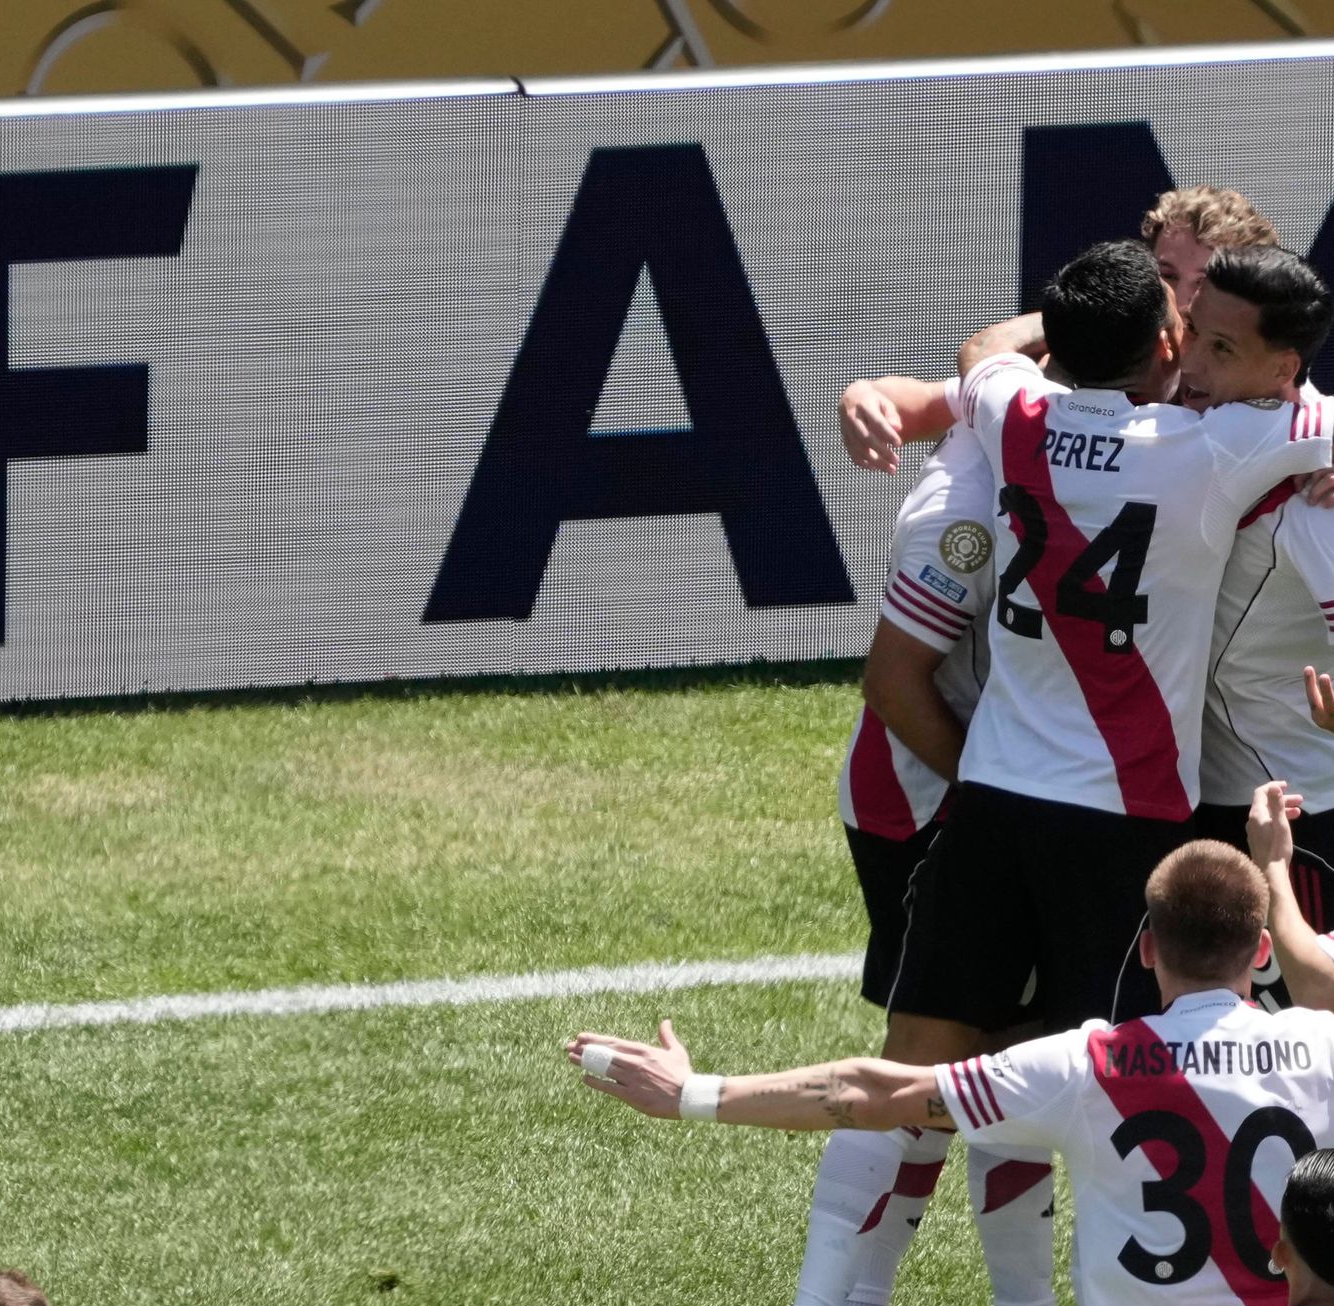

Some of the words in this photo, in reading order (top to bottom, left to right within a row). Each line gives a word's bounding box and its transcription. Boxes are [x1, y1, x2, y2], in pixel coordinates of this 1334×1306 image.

[1068, 401, 1115, 417] Grandeza
[1034, 427, 1125, 473] PEREZ
[997, 483, 1158, 655] 24
[1104, 1040, 1312, 1078] MASTANTUONO
[1111, 1106, 1319, 1285] 30
